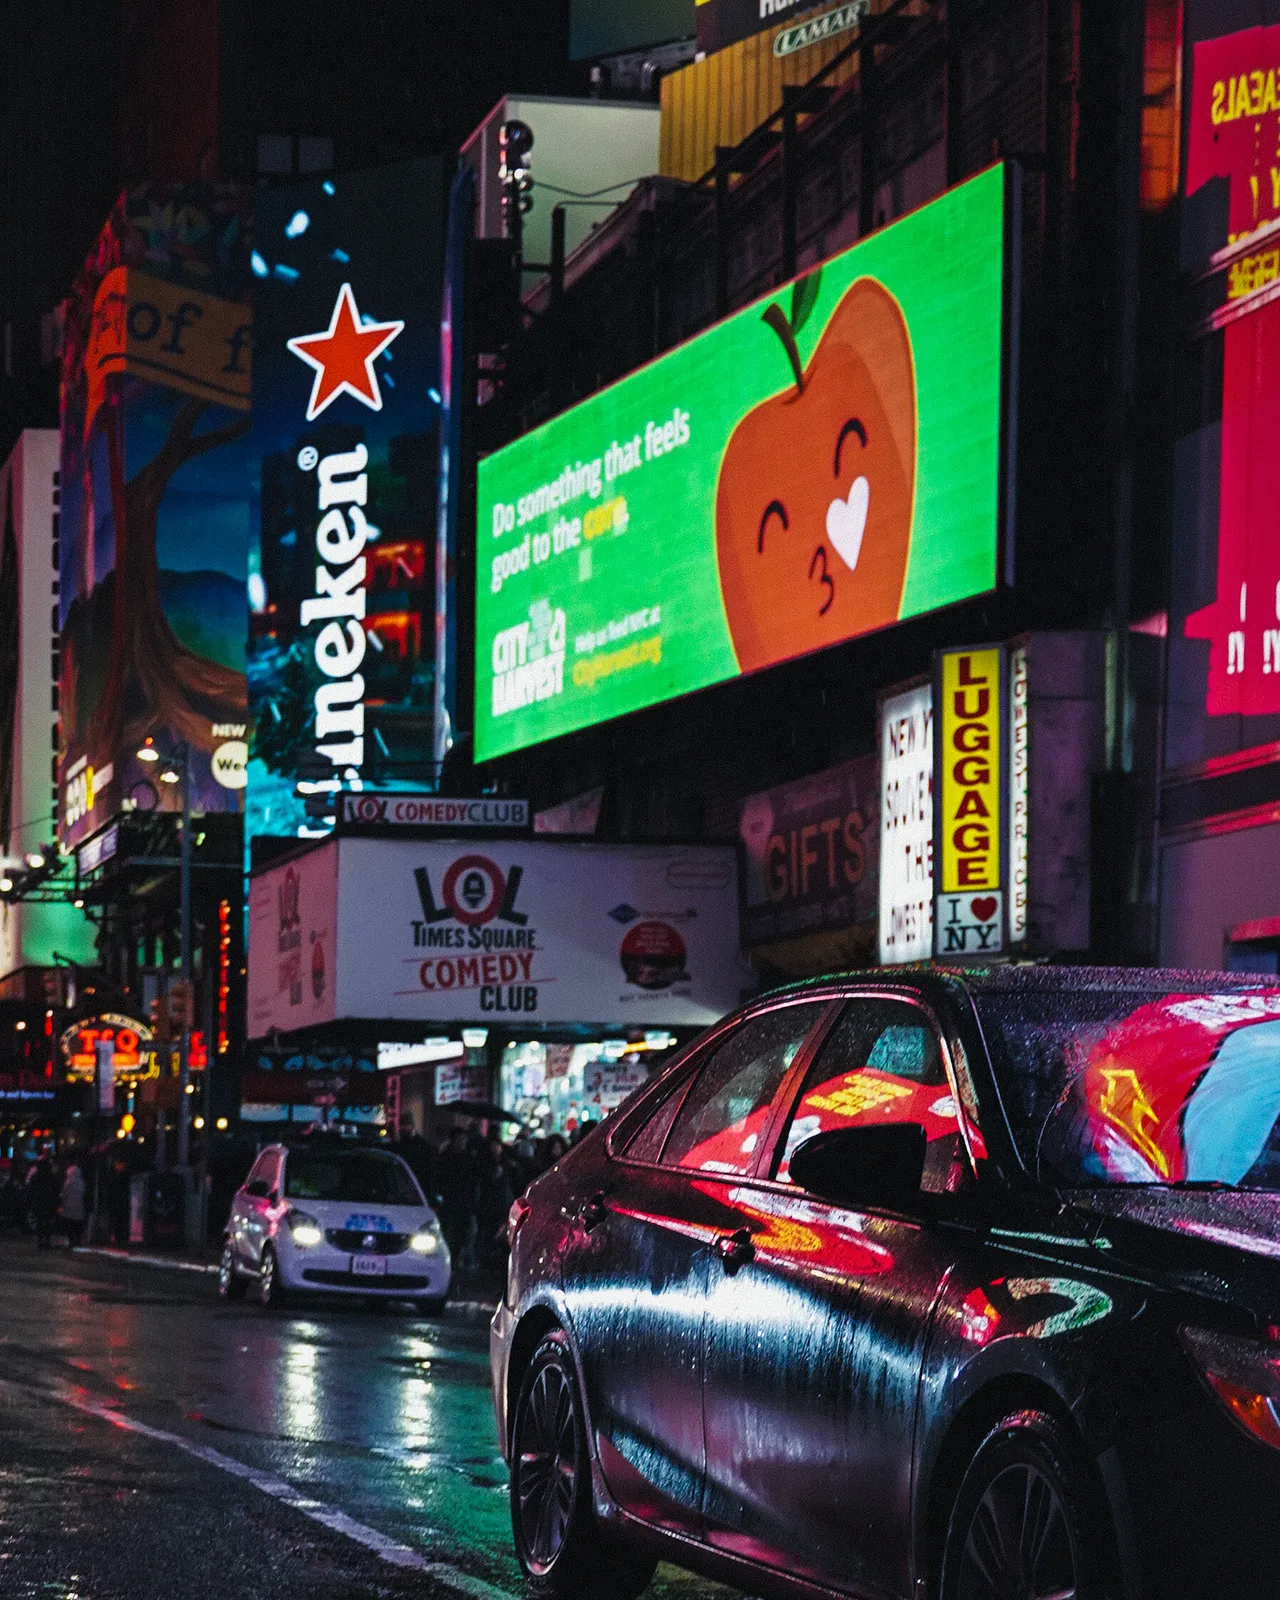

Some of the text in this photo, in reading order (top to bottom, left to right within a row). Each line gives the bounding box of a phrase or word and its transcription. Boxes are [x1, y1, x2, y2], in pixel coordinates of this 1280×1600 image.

[127, 302, 203, 354] of
[493, 407, 690, 538] Do something that feels
[492, 532, 531, 593] good
[533, 533, 550, 565] to
[553, 517, 581, 555] the
[492, 621, 530, 676] CITY
[492, 651, 566, 718] HARVEST
[211, 723, 247, 738] NEW
[952, 656, 991, 887] LUGGAGE
[763, 811, 865, 899] GIFTS
[413, 854, 529, 928] LOL
[410, 921, 537, 952] TIMES SQUARE
[943, 925, 994, 951] NY
[419, 951, 535, 990] COMEDY
[479, 985, 539, 1013] CLUB
